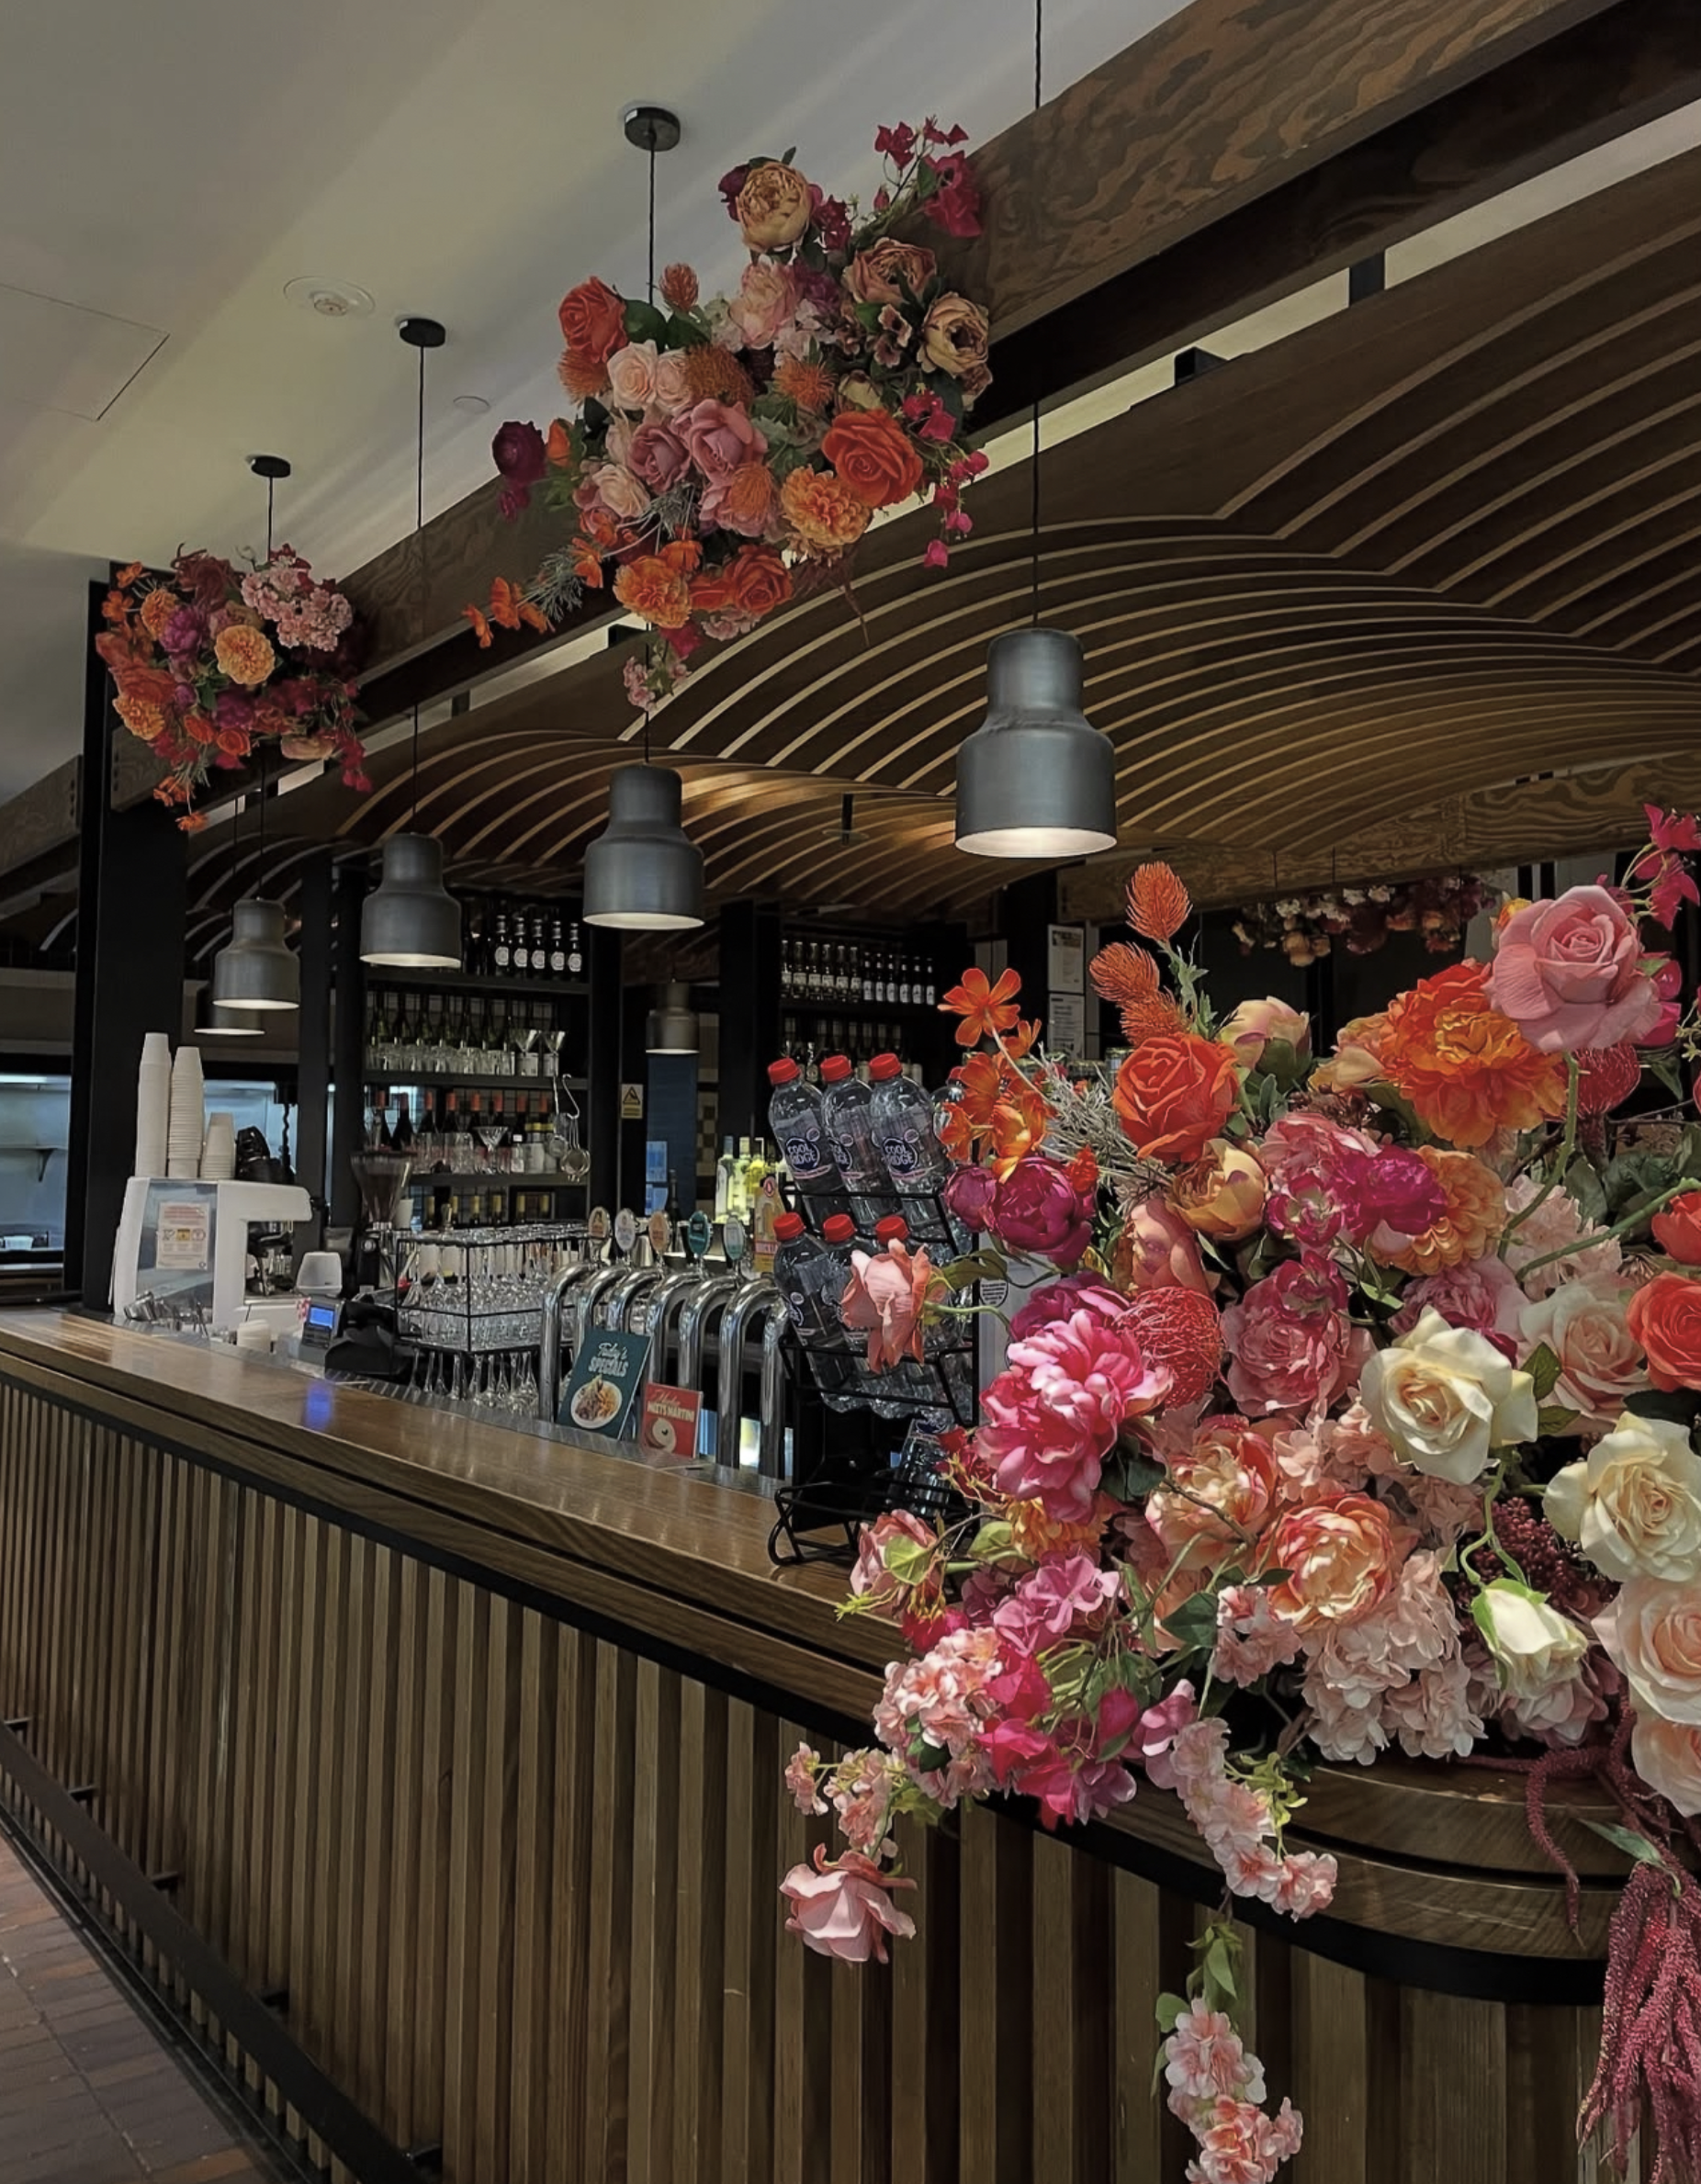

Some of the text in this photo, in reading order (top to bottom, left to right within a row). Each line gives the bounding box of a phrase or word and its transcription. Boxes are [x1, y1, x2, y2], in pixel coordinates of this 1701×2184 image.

[787, 1143, 812, 1155] COOL
[884, 1143, 907, 1156] COOL
[588, 1356, 629, 1377] SPECIALS
[667, 1405, 695, 1423] MARTINI
